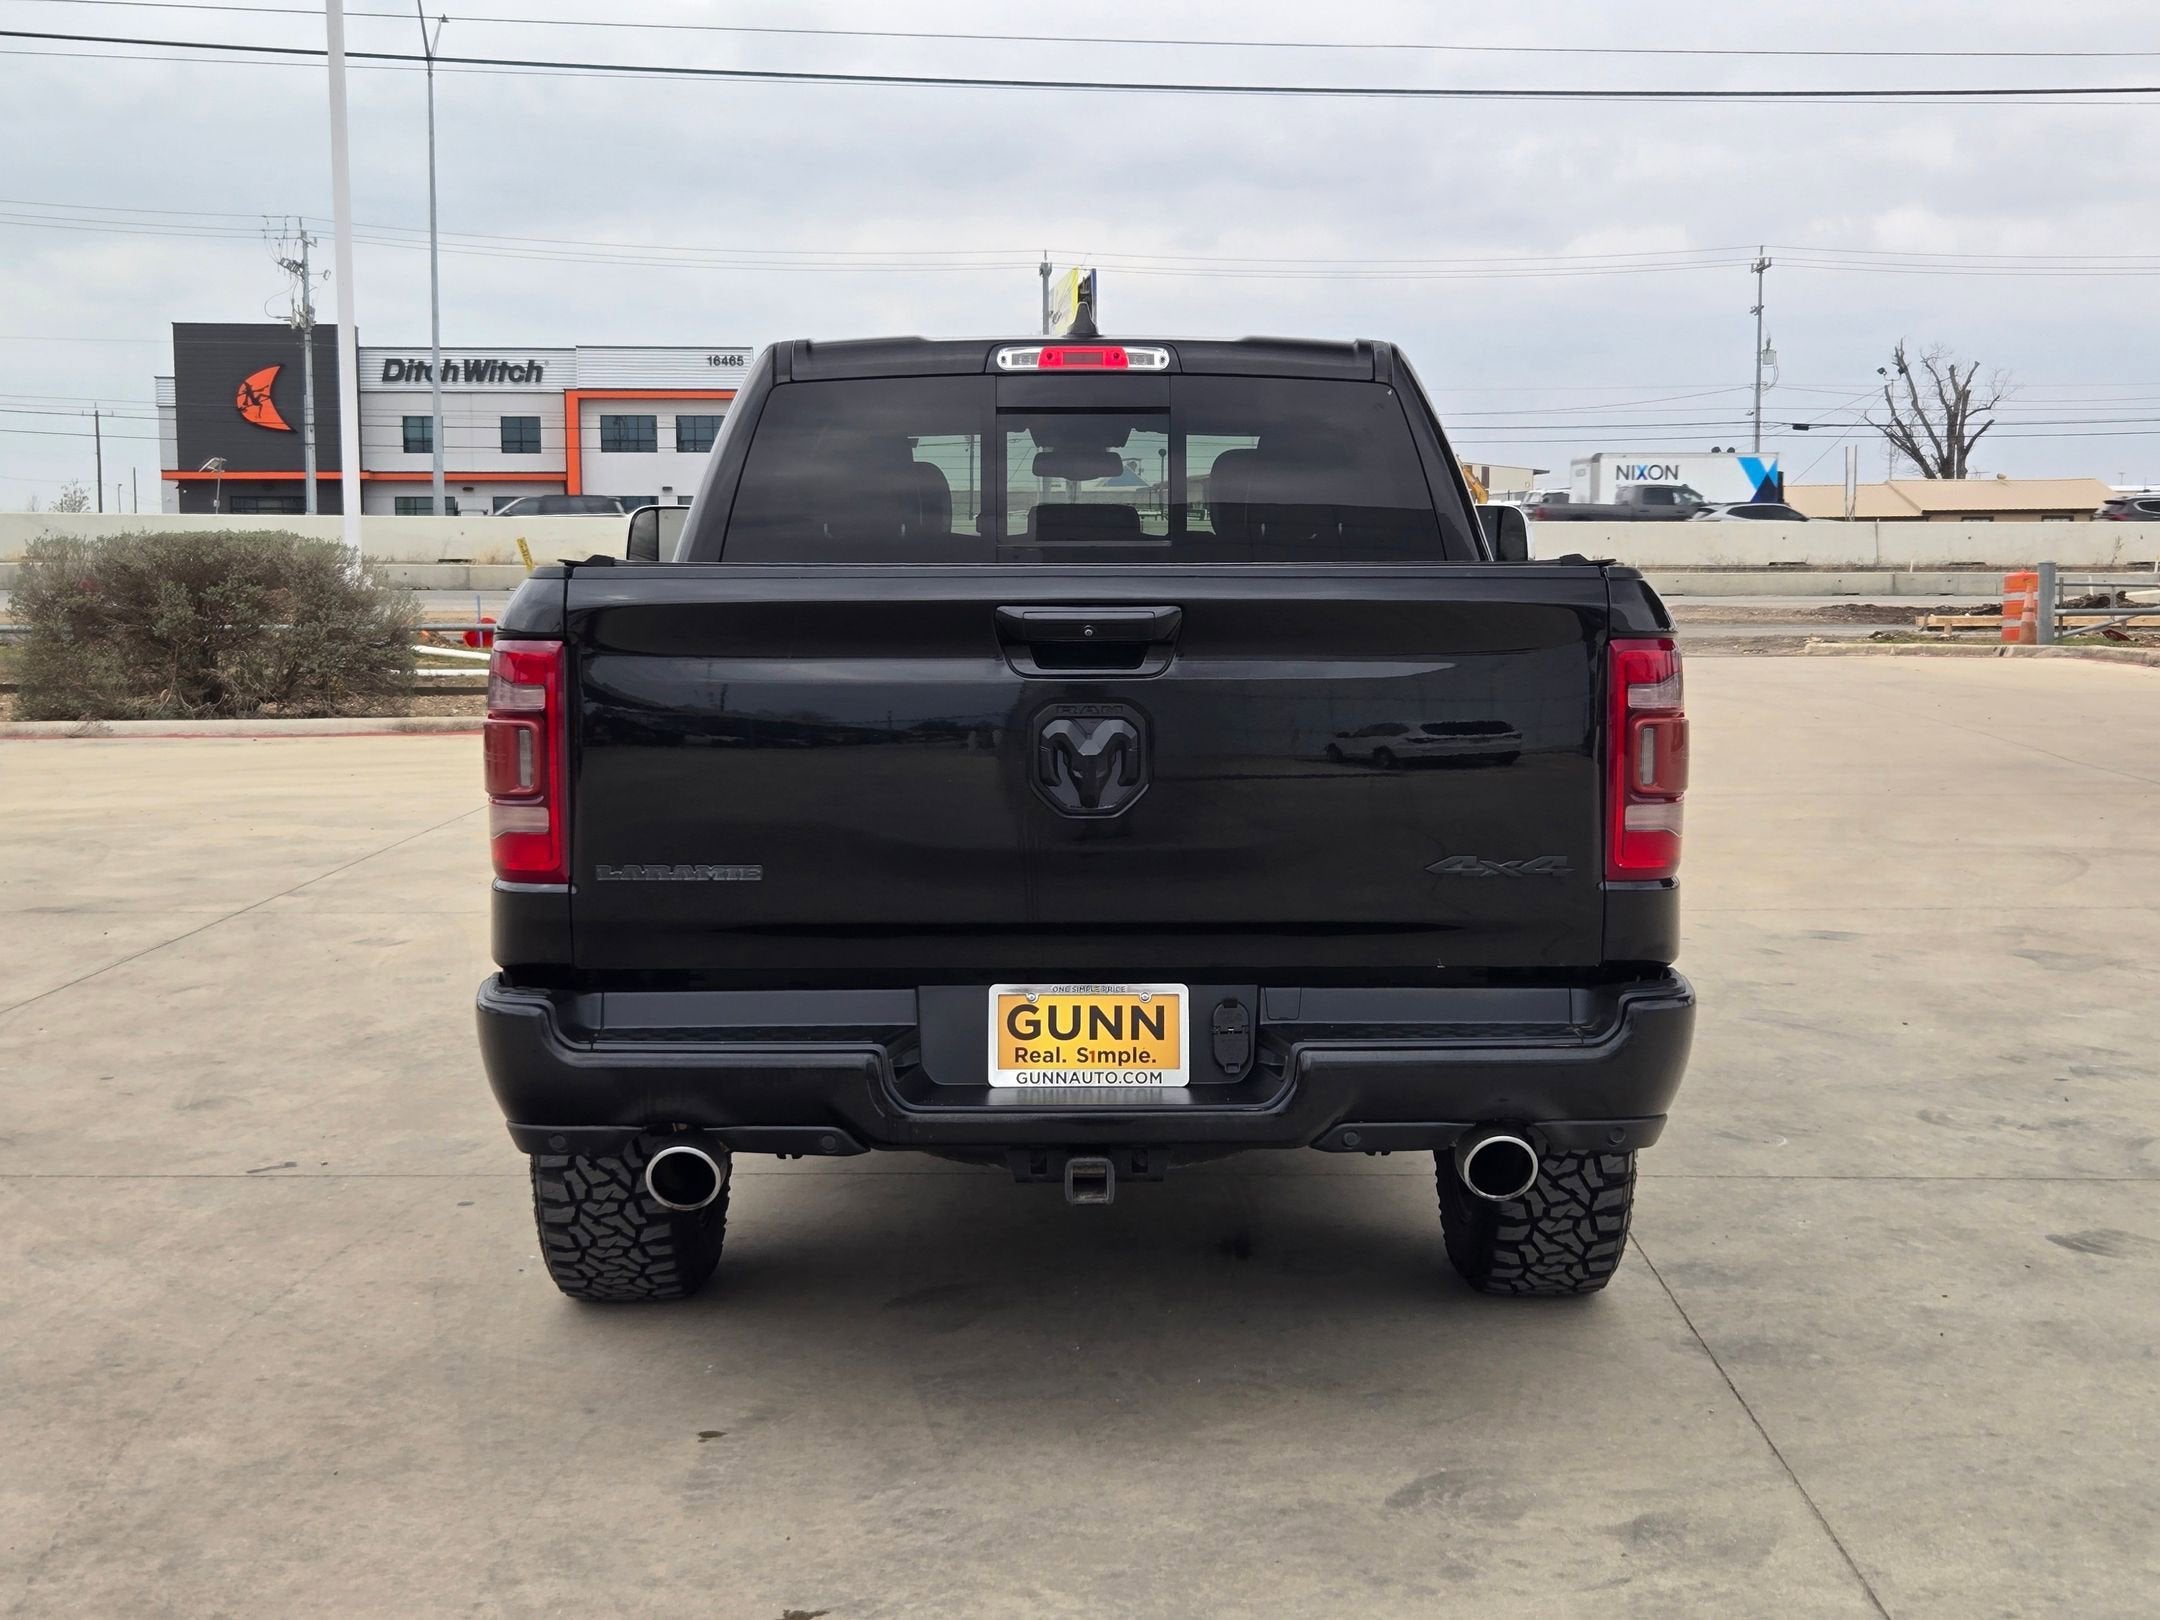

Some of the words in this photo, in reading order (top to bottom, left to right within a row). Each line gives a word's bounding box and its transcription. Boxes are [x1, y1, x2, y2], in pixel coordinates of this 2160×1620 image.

[707, 355, 744, 367] 16465
[463, 359, 544, 383] Witch
[1616, 464, 1680, 481] NIXON
[1056, 704, 1123, 716] RAM
[596, 864, 763, 881] LARAMIE
[1052, 985, 1071, 993] ONE
[1072, 985, 1100, 993] SIMPLE
[1102, 985, 1126, 993] PRICE
[1007, 1004, 1165, 1041] GUNN
[1014, 1047, 1067, 1064] Real.
[1016, 1071, 1163, 1085] GUNNAUTO.COM
